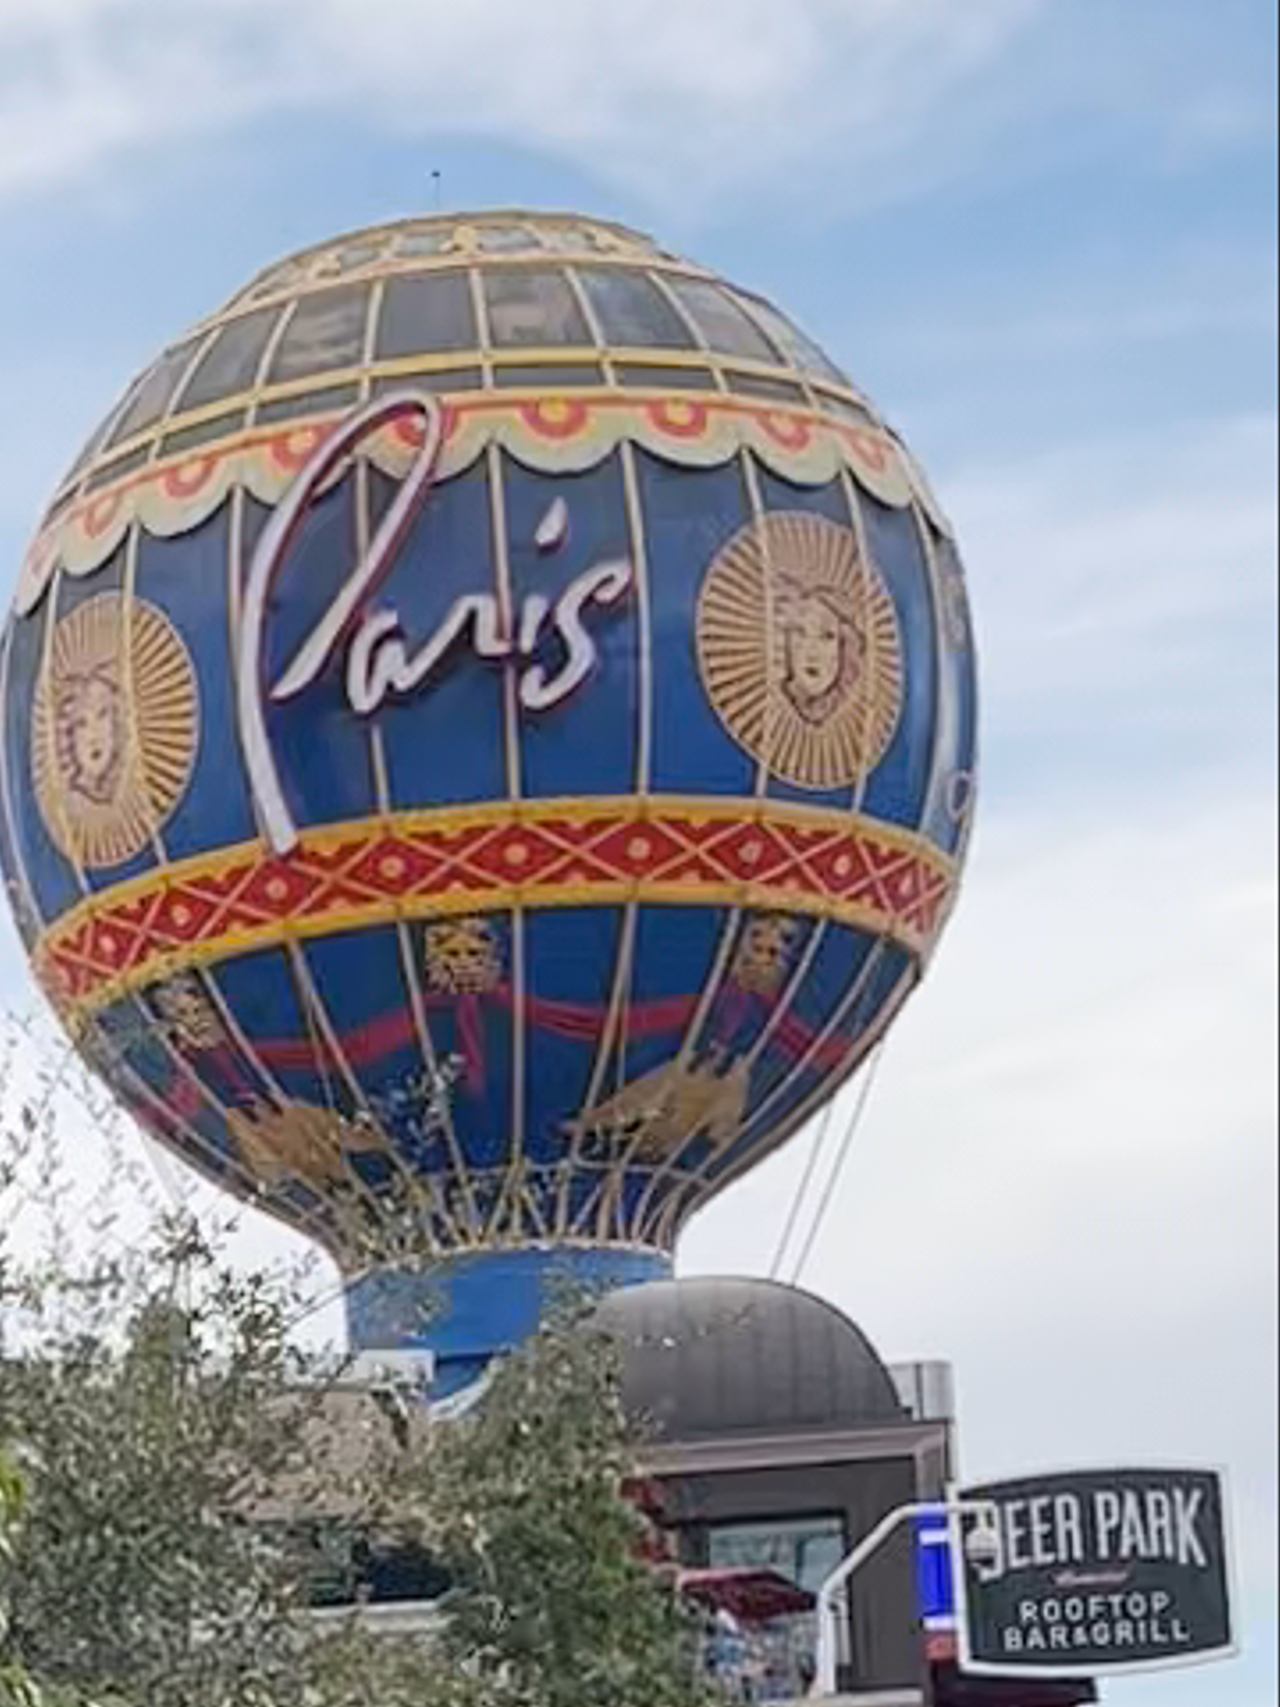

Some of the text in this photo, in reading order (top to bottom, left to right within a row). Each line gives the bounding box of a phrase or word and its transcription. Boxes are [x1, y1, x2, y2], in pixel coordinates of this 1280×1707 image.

[241, 389, 633, 855] Paris
[1093, 1487, 1208, 1568] PARK
[1019, 1590, 1171, 1622] ROOFTOP
